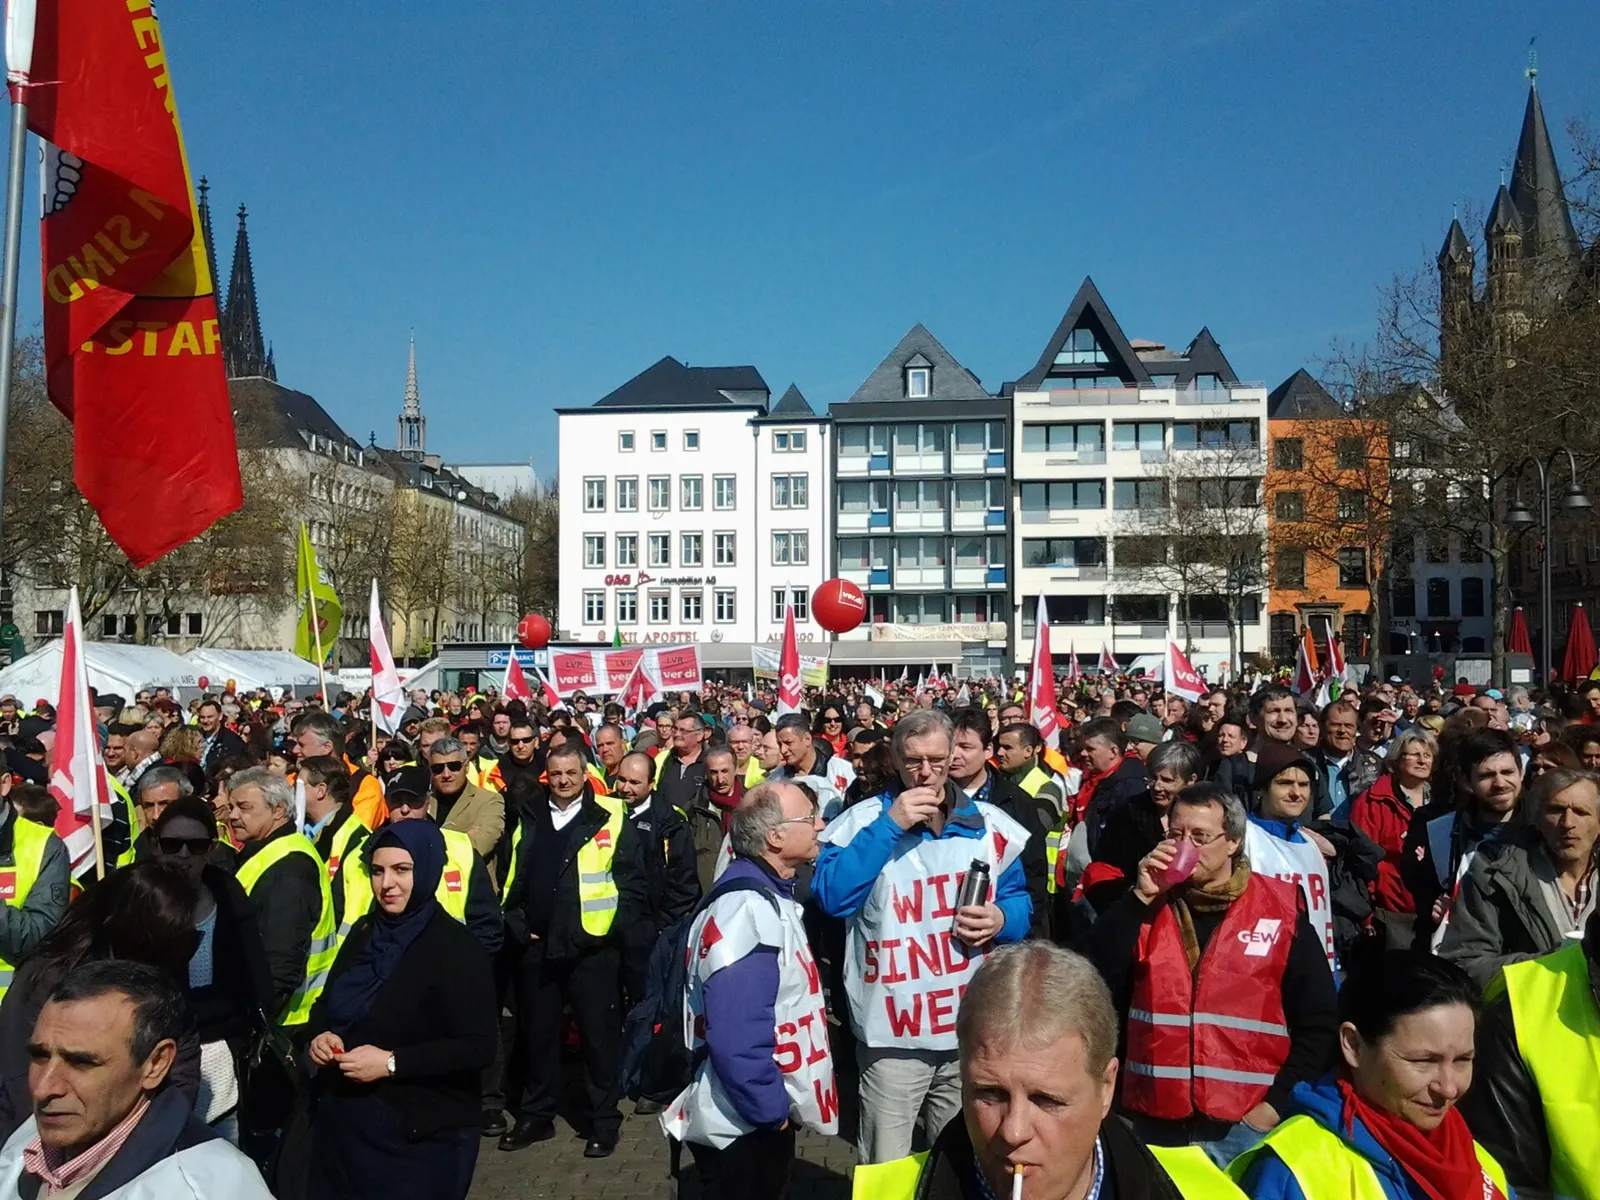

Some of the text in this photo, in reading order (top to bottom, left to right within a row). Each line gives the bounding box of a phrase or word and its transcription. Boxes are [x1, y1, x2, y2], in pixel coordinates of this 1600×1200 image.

[604, 574, 631, 586] GAG
[705, 575, 717, 586] AG
[643, 631, 699, 643] APOSTEL
[666, 656, 685, 664] LVR
[663, 669, 697, 679] ver.di
[1237, 930, 1279, 943] GEW
